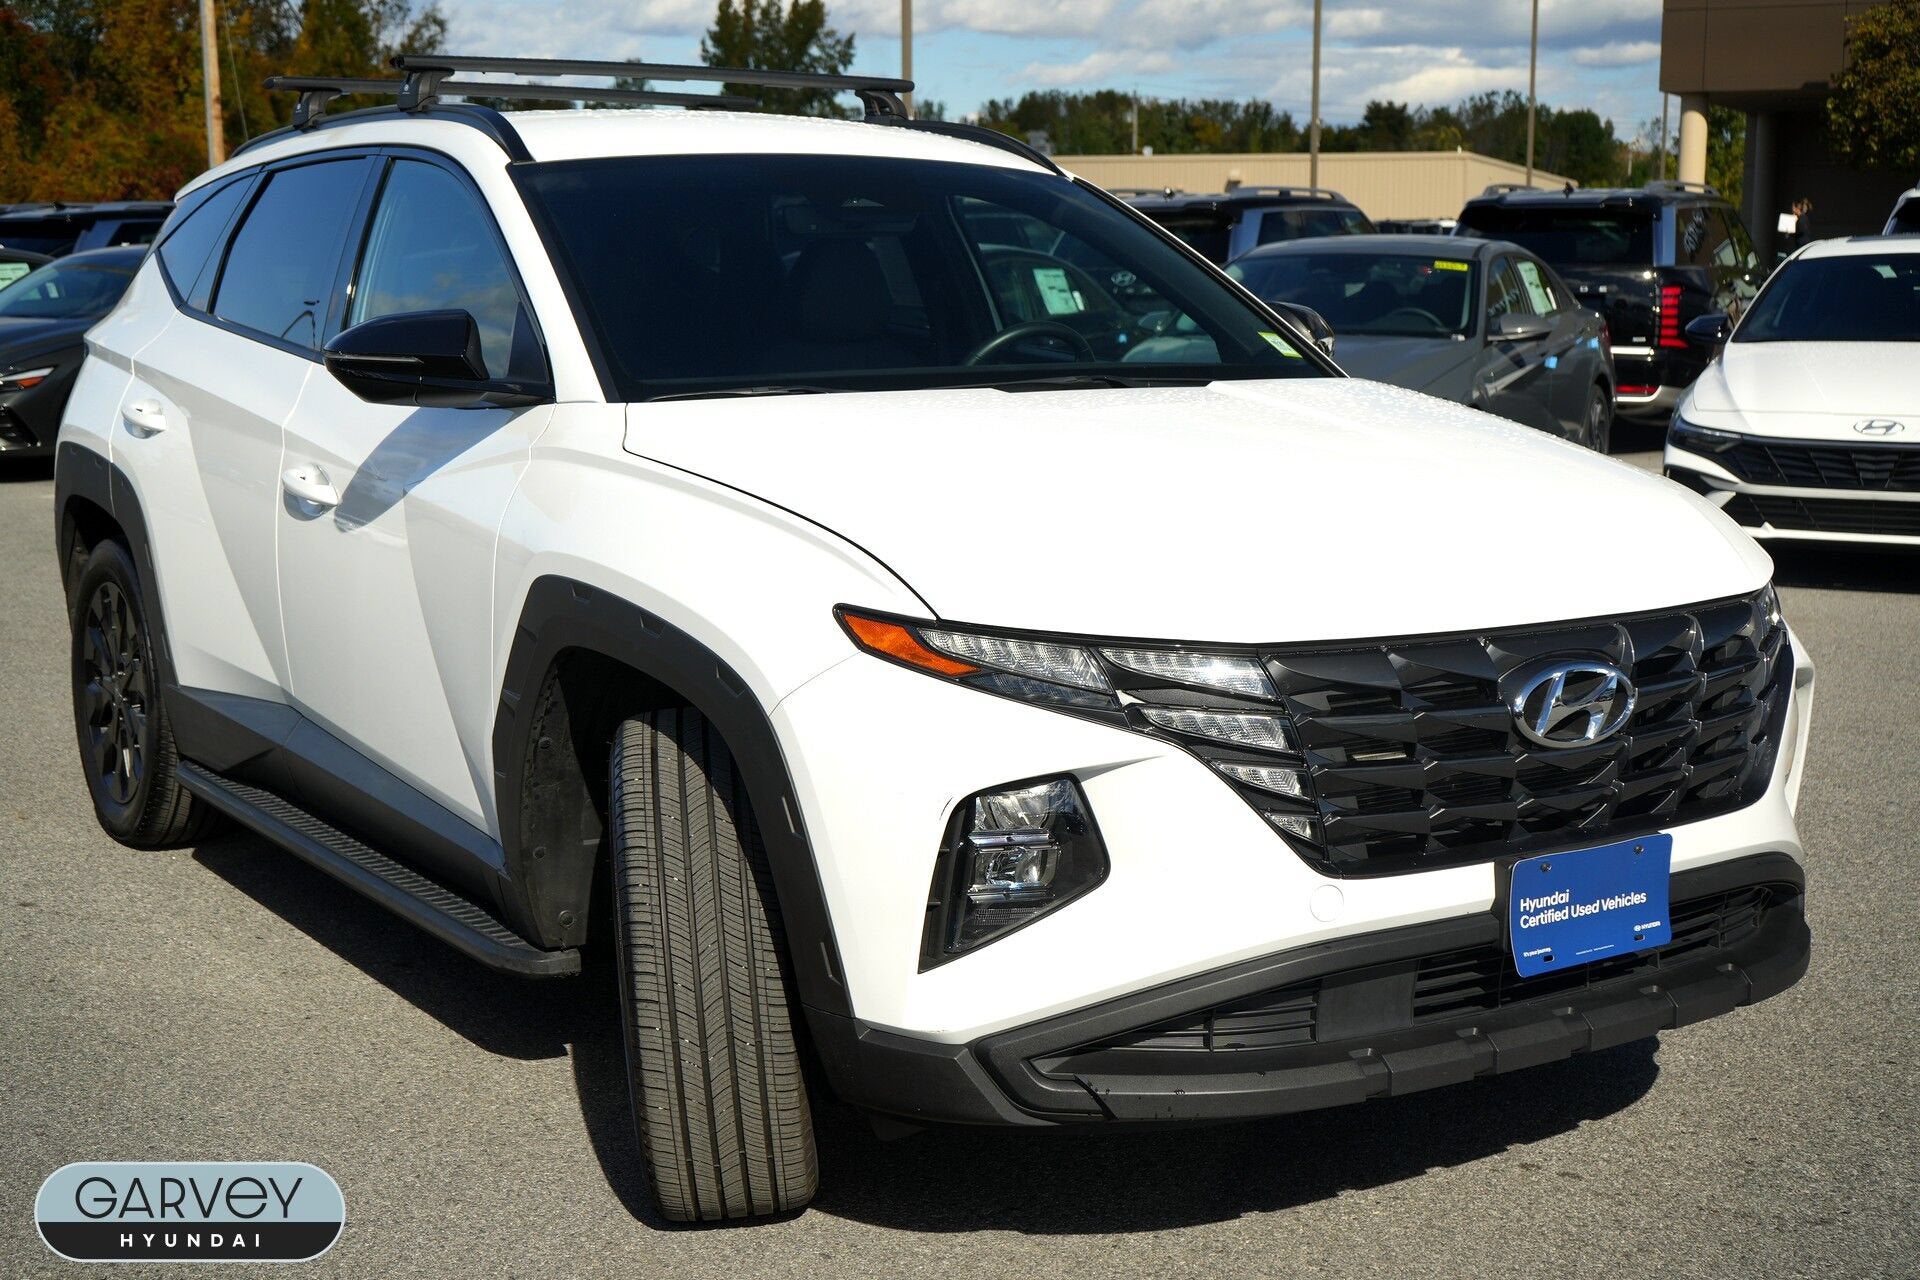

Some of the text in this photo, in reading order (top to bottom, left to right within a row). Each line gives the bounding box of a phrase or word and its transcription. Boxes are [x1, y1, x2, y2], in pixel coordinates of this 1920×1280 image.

[1520, 889, 1570, 912] Hyundai
[1520, 892, 1647, 929] Certified Used Vehicles
